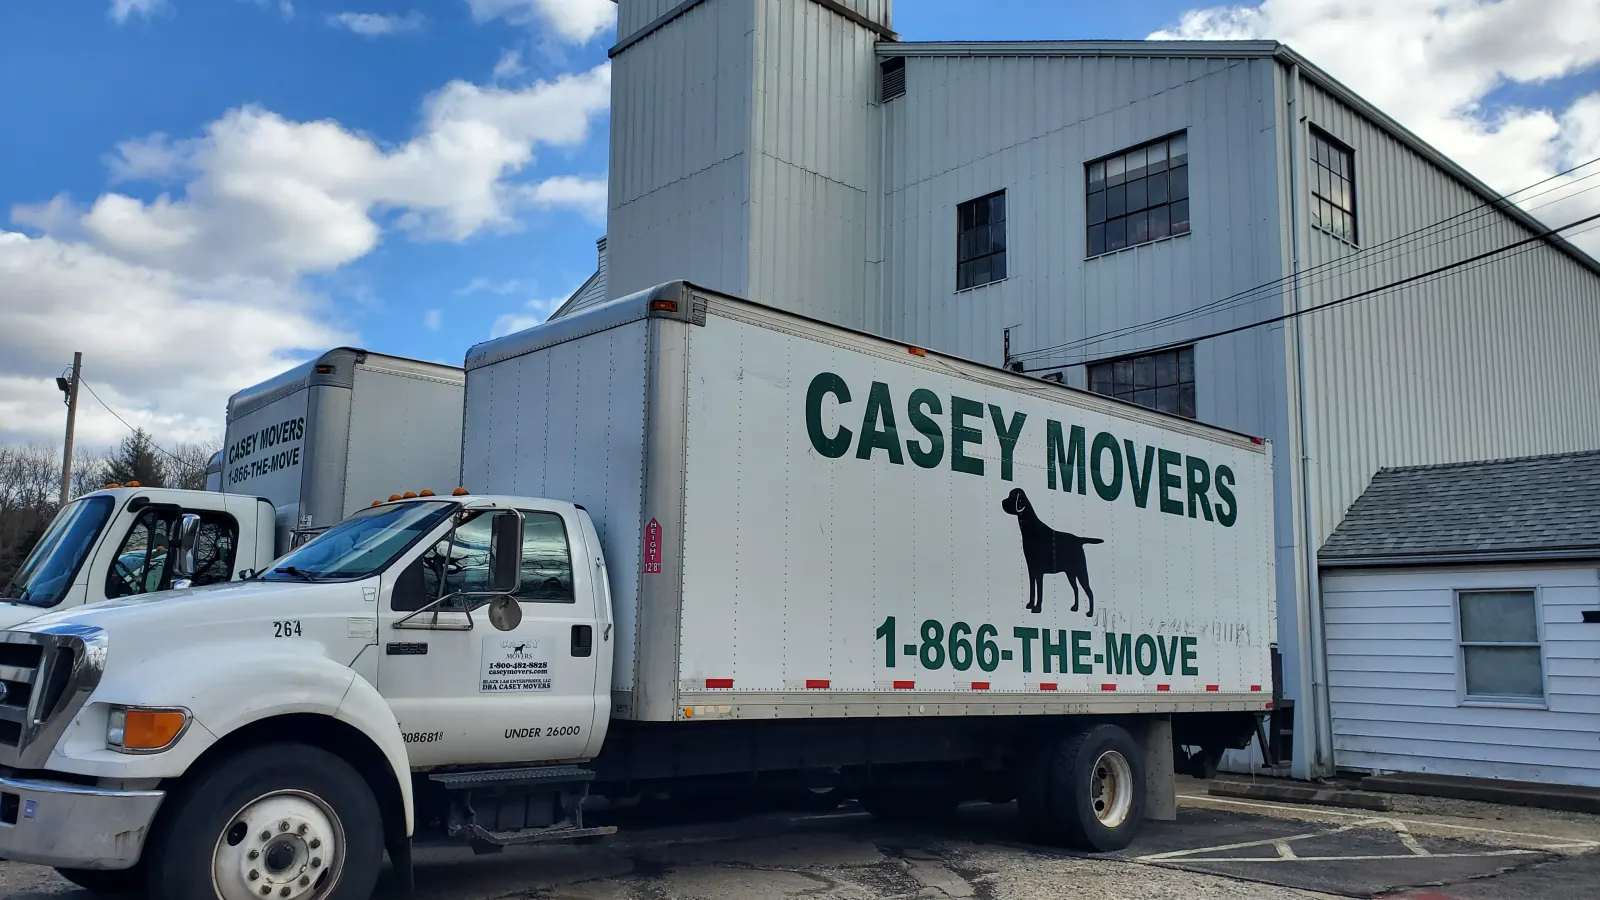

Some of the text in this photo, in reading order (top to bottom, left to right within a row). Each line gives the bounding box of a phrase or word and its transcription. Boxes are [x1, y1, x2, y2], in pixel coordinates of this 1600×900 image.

[229, 417, 304, 465] CASEY MOVERS
[804, 371, 1238, 528] CASEY MOVERS
[228, 447, 300, 486] 1-866-THE-MOVE
[649, 522, 658, 561] HEIGHT
[273, 620, 303, 638] 264
[875, 615, 1199, 676] 1-866-THE-MOVE
[504, 725, 581, 739] UNDER 26000
